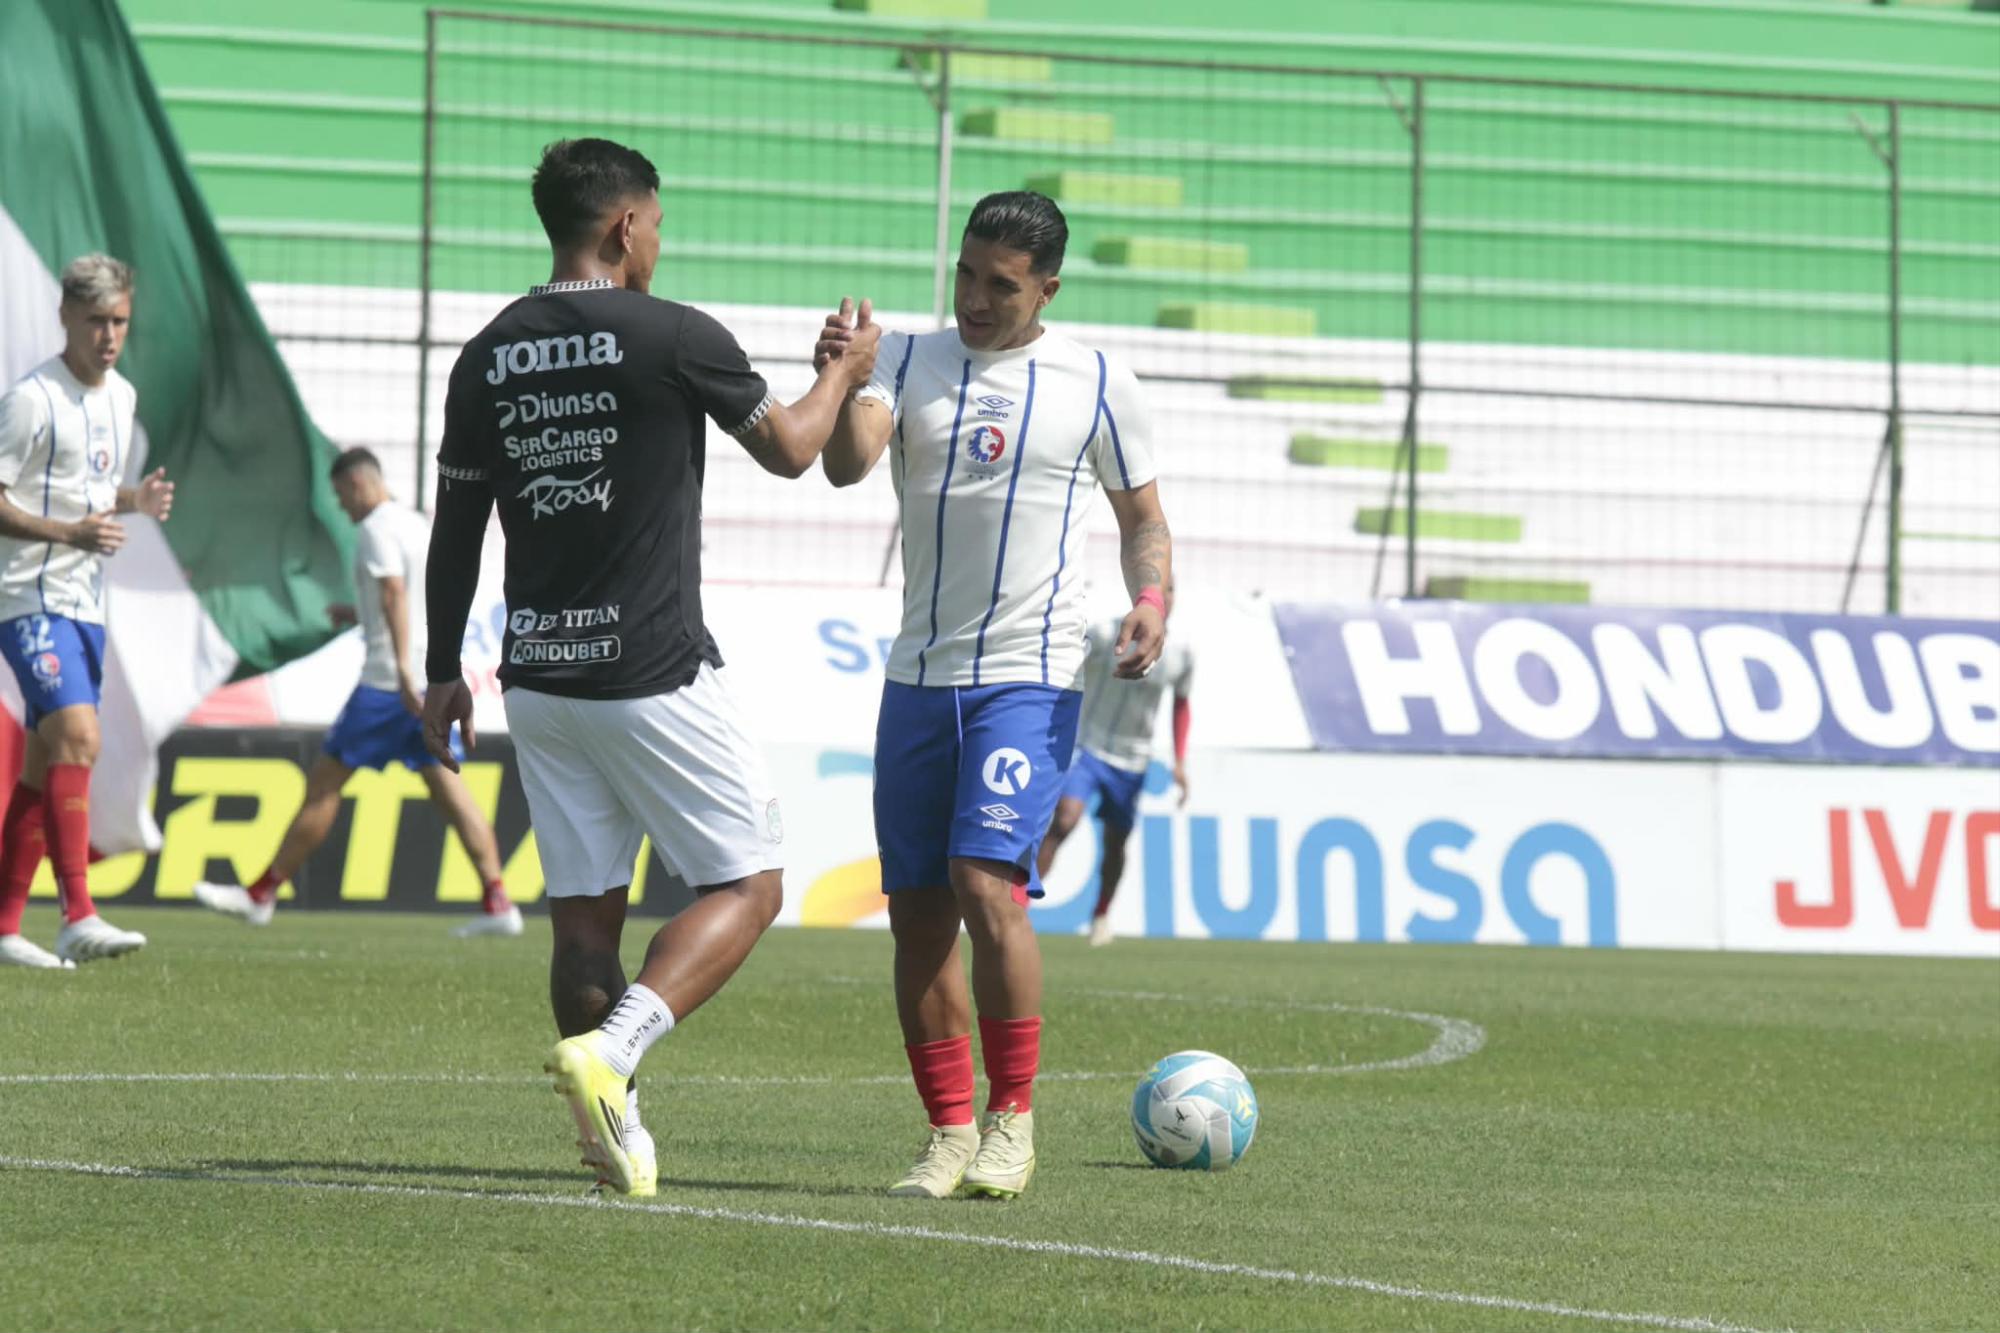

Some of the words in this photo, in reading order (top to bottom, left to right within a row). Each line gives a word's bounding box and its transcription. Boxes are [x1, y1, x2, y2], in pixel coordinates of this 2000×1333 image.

[518, 391, 618, 423] Diunsa
[977, 409, 1009, 418] umbro
[521, 446, 604, 472] LOGISTICS
[516, 465, 616, 520] Rosy
[562, 605, 620, 628] TITAN
[16, 613, 55, 656] 32
[982, 820, 1013, 832] umbro
